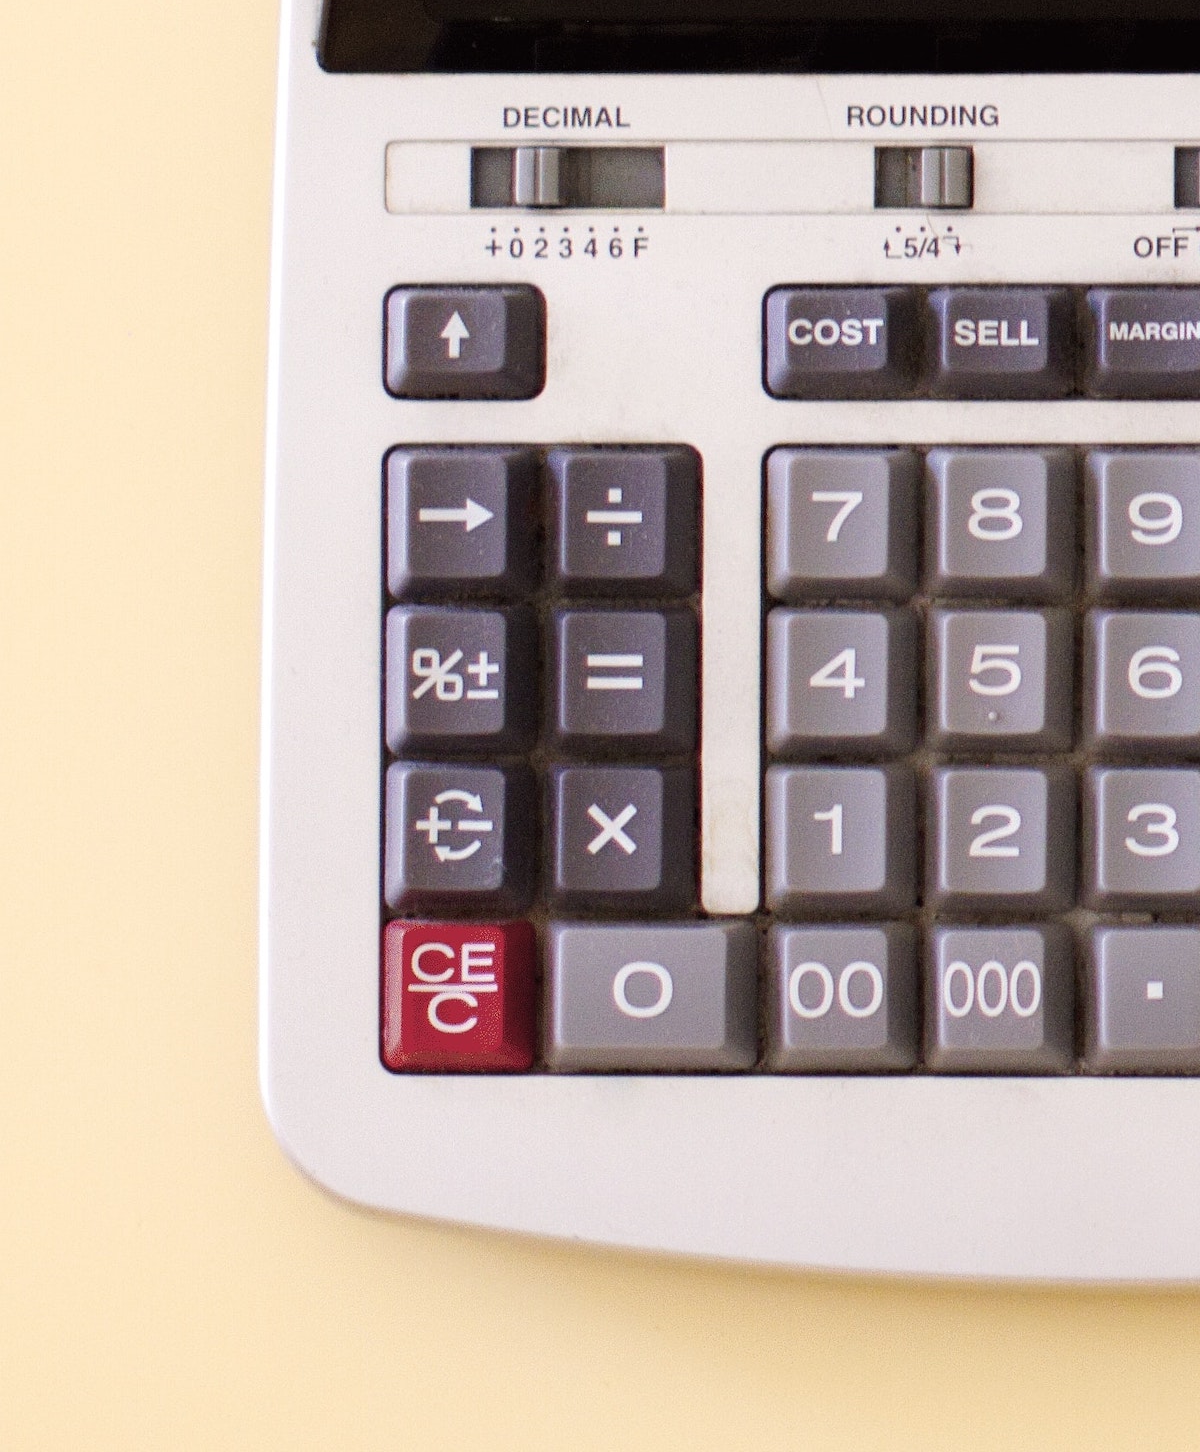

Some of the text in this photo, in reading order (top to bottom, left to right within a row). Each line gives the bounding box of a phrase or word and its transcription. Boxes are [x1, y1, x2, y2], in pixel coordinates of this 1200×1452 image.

[502, 106, 631, 129] DECIMAL
[846, 104, 999, 127] ROUNDING
[509, 237, 524, 259] 0
[534, 237, 549, 259] 2
[558, 237, 573, 259] 3
[583, 237, 598, 258] 4
[608, 237, 624, 259] 6
[633, 237, 648, 258] F
[904, 236, 940, 259] 5/4
[1133, 236, 1189, 259] OFF
[787, 318, 884, 346] COST
[954, 319, 1040, 347] SELL
[811, 491, 863, 542] 7
[968, 488, 1023, 541] 8
[1128, 492, 1183, 545] 9
[809, 648, 866, 699] 4
[968, 644, 1022, 696] 5
[1128, 646, 1183, 699] 6
[813, 804, 843, 855] 1
[969, 804, 1022, 858] 2
[1125, 803, 1180, 857] 3
[411, 942, 496, 983] CE
[427, 991, 477, 1034] C
[612, 961, 673, 1018] 0
[788, 960, 883, 1019] 00
[943, 960, 1041, 1019] 000
